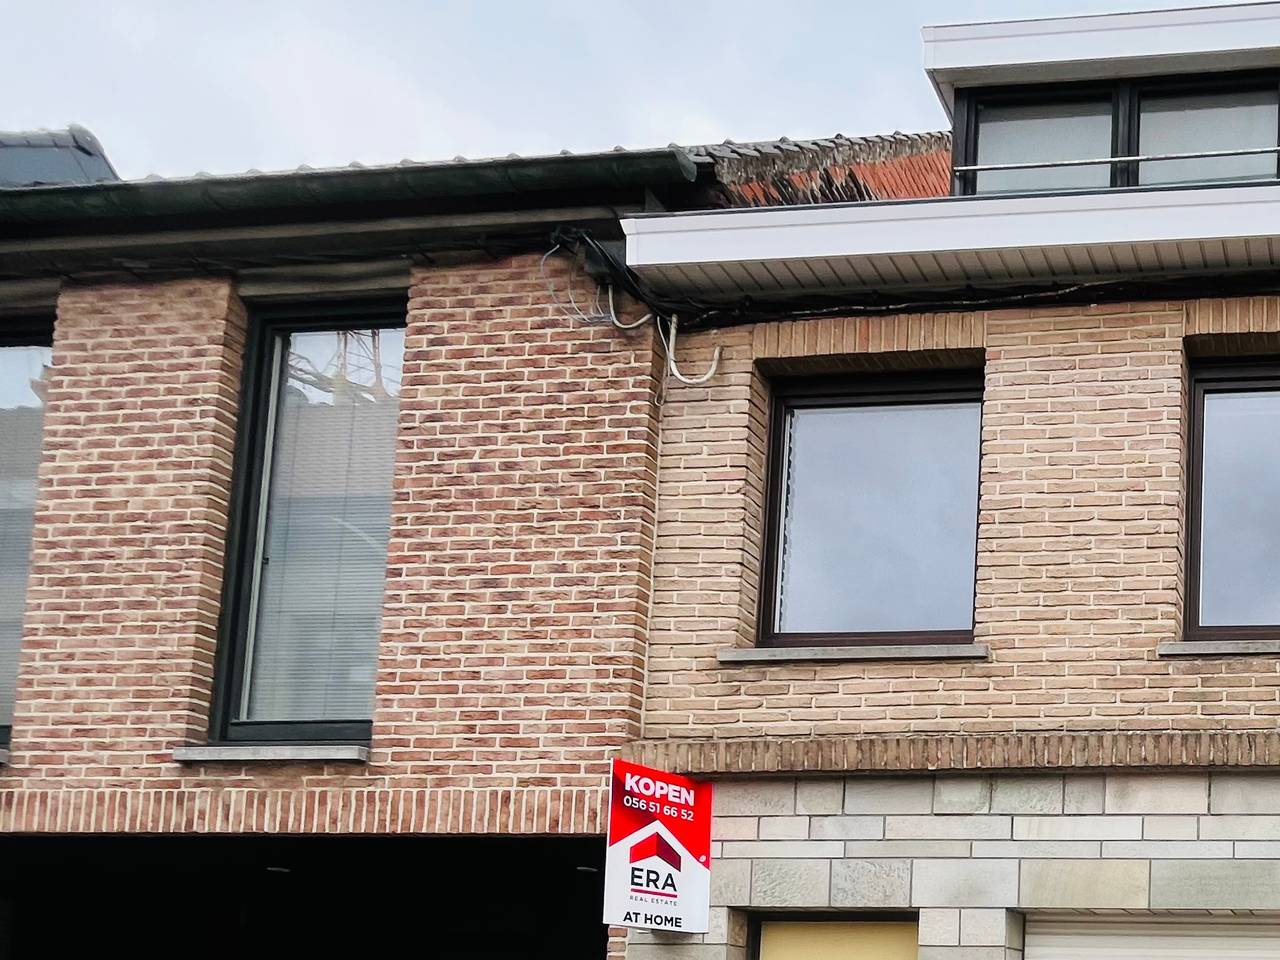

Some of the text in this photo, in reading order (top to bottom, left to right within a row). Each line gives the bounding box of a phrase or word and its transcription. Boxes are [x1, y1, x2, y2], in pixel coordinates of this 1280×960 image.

[625, 772, 695, 806] KOPEN
[623, 795, 694, 821] 056 51 66 52
[630, 866, 677, 892] ERA
[629, 895, 677, 906] REAL ESTATE
[623, 911, 682, 928] AT HOME
